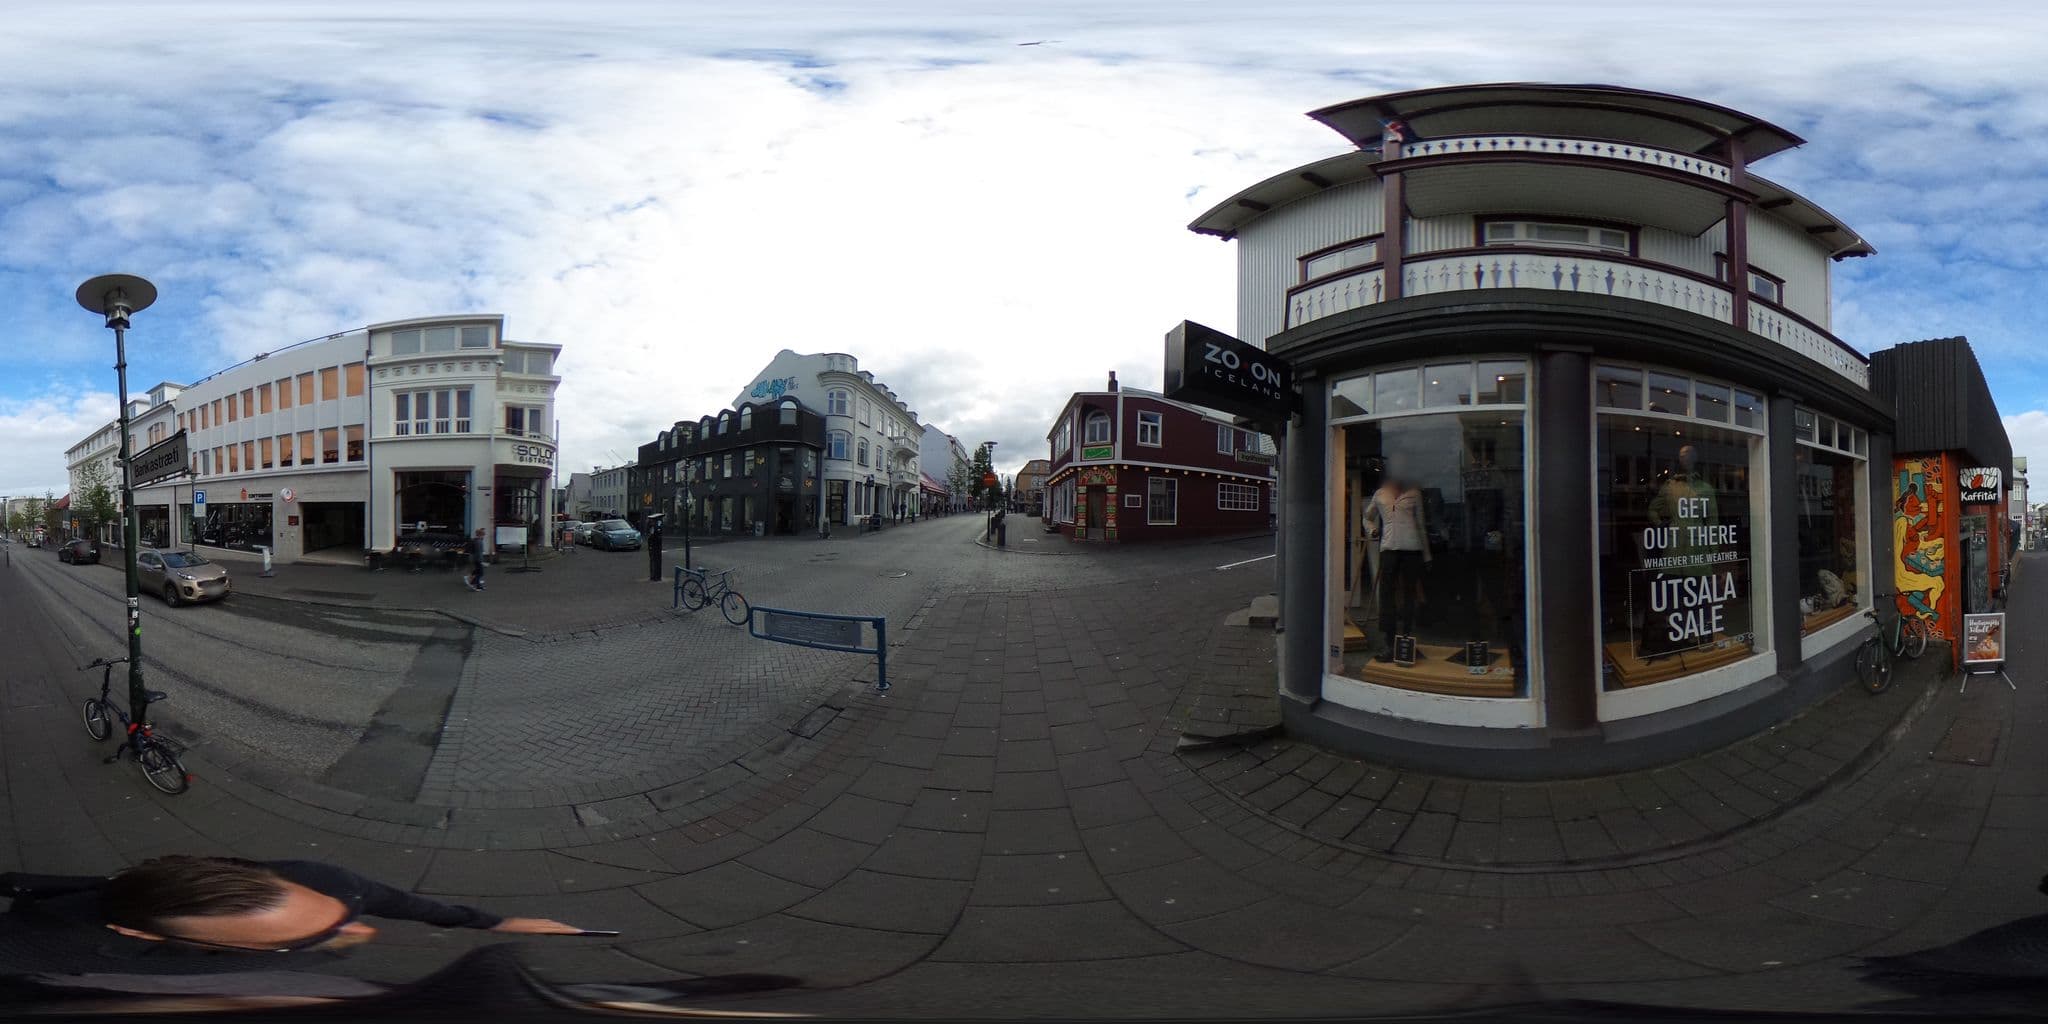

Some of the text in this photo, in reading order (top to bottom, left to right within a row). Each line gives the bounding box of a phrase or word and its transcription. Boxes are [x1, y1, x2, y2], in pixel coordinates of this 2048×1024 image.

[1204, 366, 1281, 400] ICELAND
[134, 445, 179, 477] Bankastræti
[197, 493, 204, 503] P
[1677, 497, 1710, 519] GET
[1960, 491, 1998, 502] Kaffitár
[1643, 524, 1738, 550] OUT THERE
[1643, 551, 1738, 569] WHATEVER THE WEATHER
[1650, 571, 1737, 613] ÚTSALA
[1668, 604, 1725, 642] SALE
